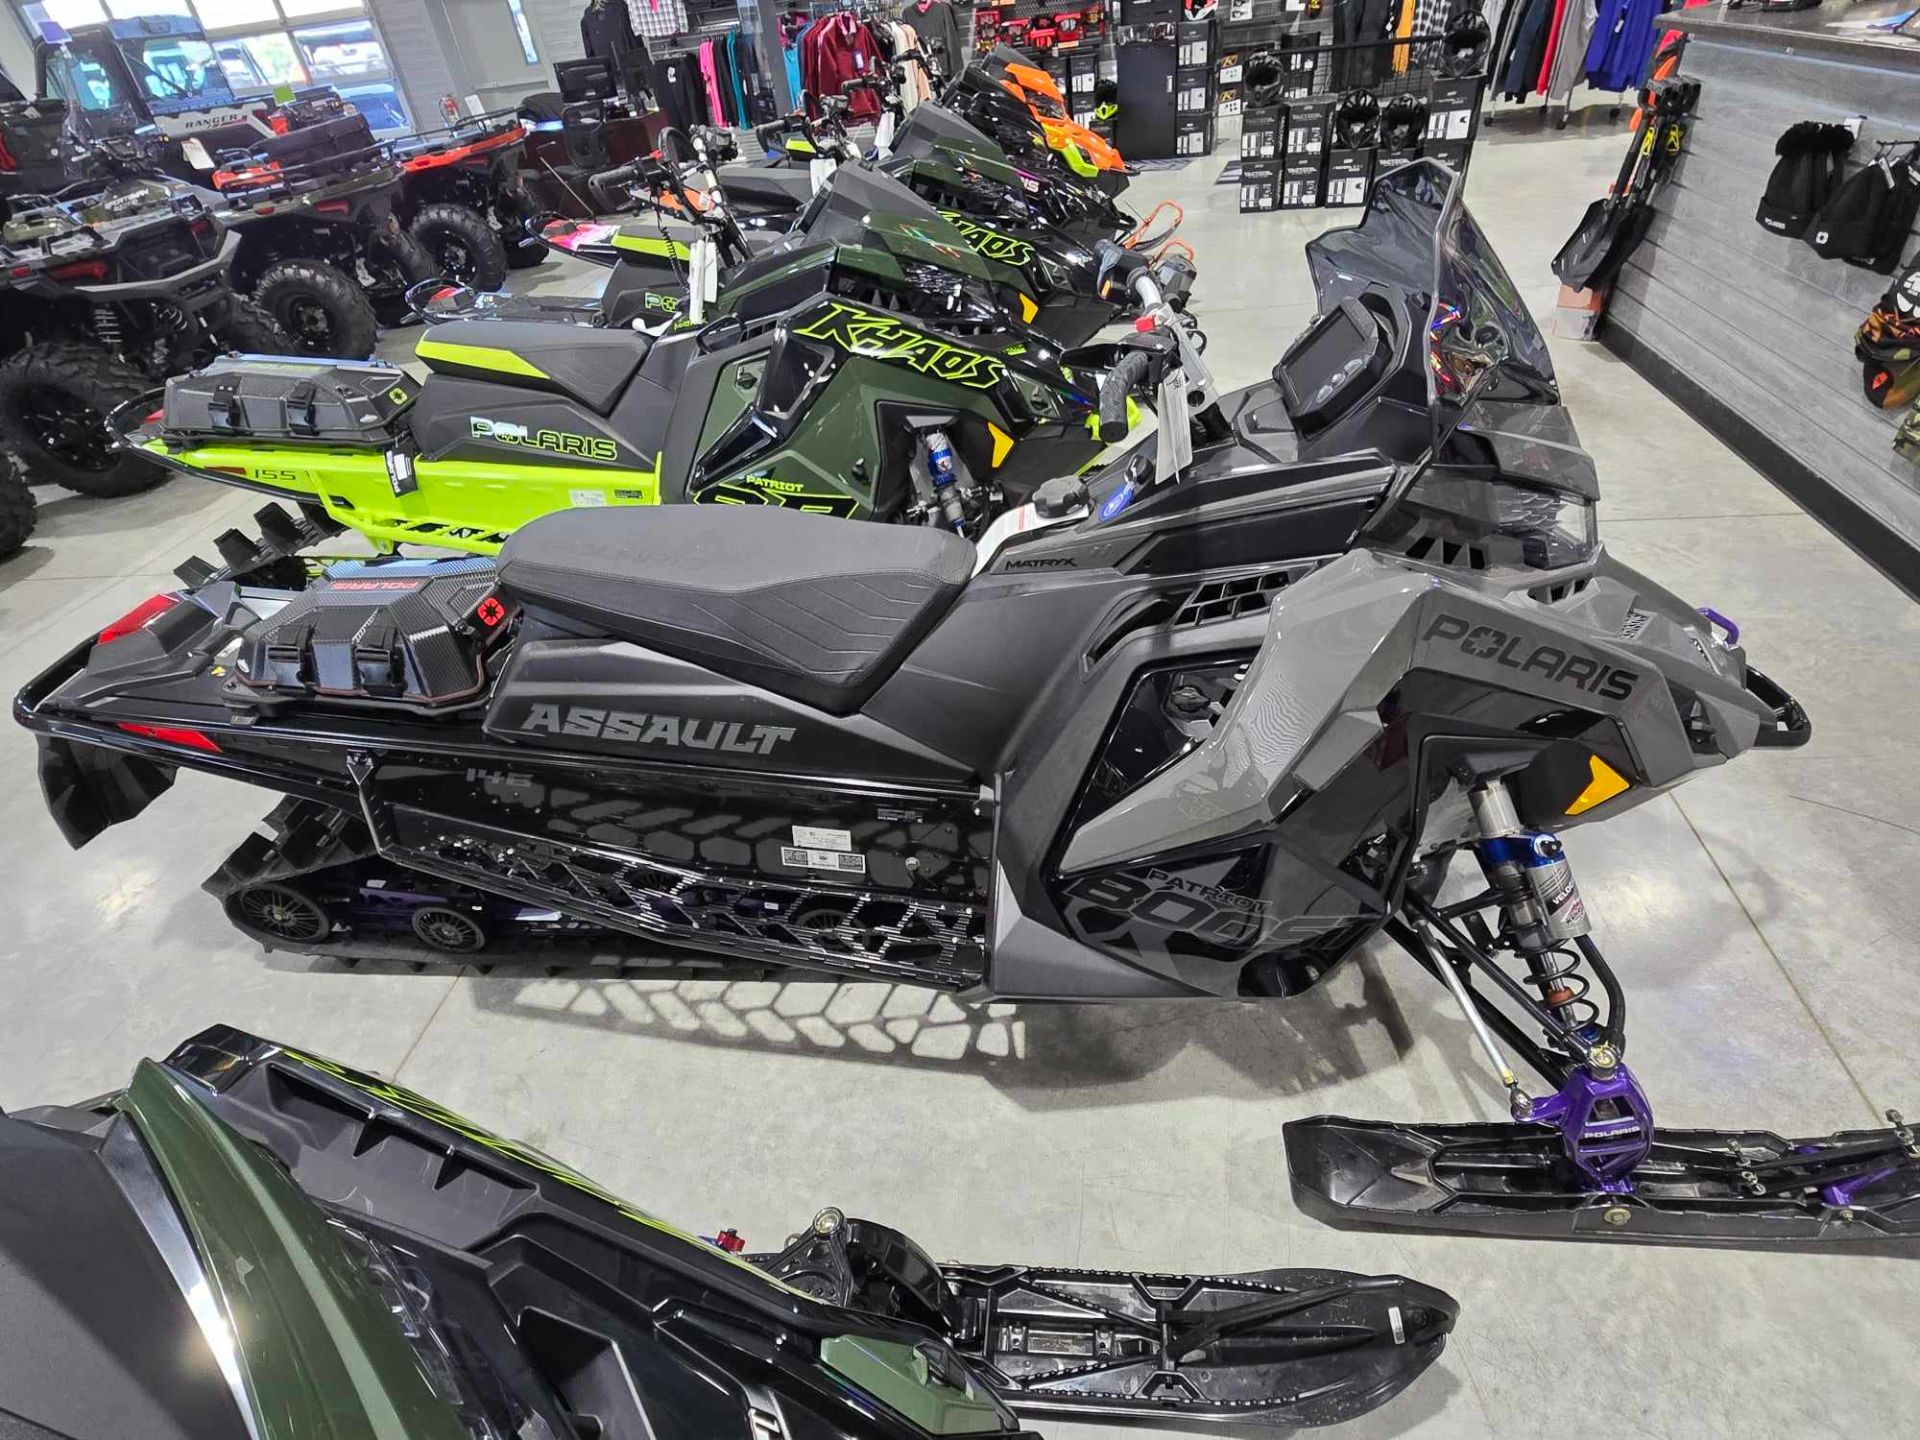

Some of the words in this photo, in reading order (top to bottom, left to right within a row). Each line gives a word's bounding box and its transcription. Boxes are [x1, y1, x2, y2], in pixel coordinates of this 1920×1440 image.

[184, 113, 238, 130] RANGER
[792, 302, 1006, 390] KHAOS
[469, 415, 618, 461] POLARIS
[253, 468, 297, 481] 155
[745, 473, 805, 493] PATRIOT
[1004, 557, 1079, 571] MATRYX
[1422, 614, 1641, 703] POLARIS
[521, 702, 798, 756] ASSAULT
[465, 767, 535, 788] 146
[1148, 868, 1274, 914] PATRIOT
[1583, 1125, 1641, 1139] POLARIS
